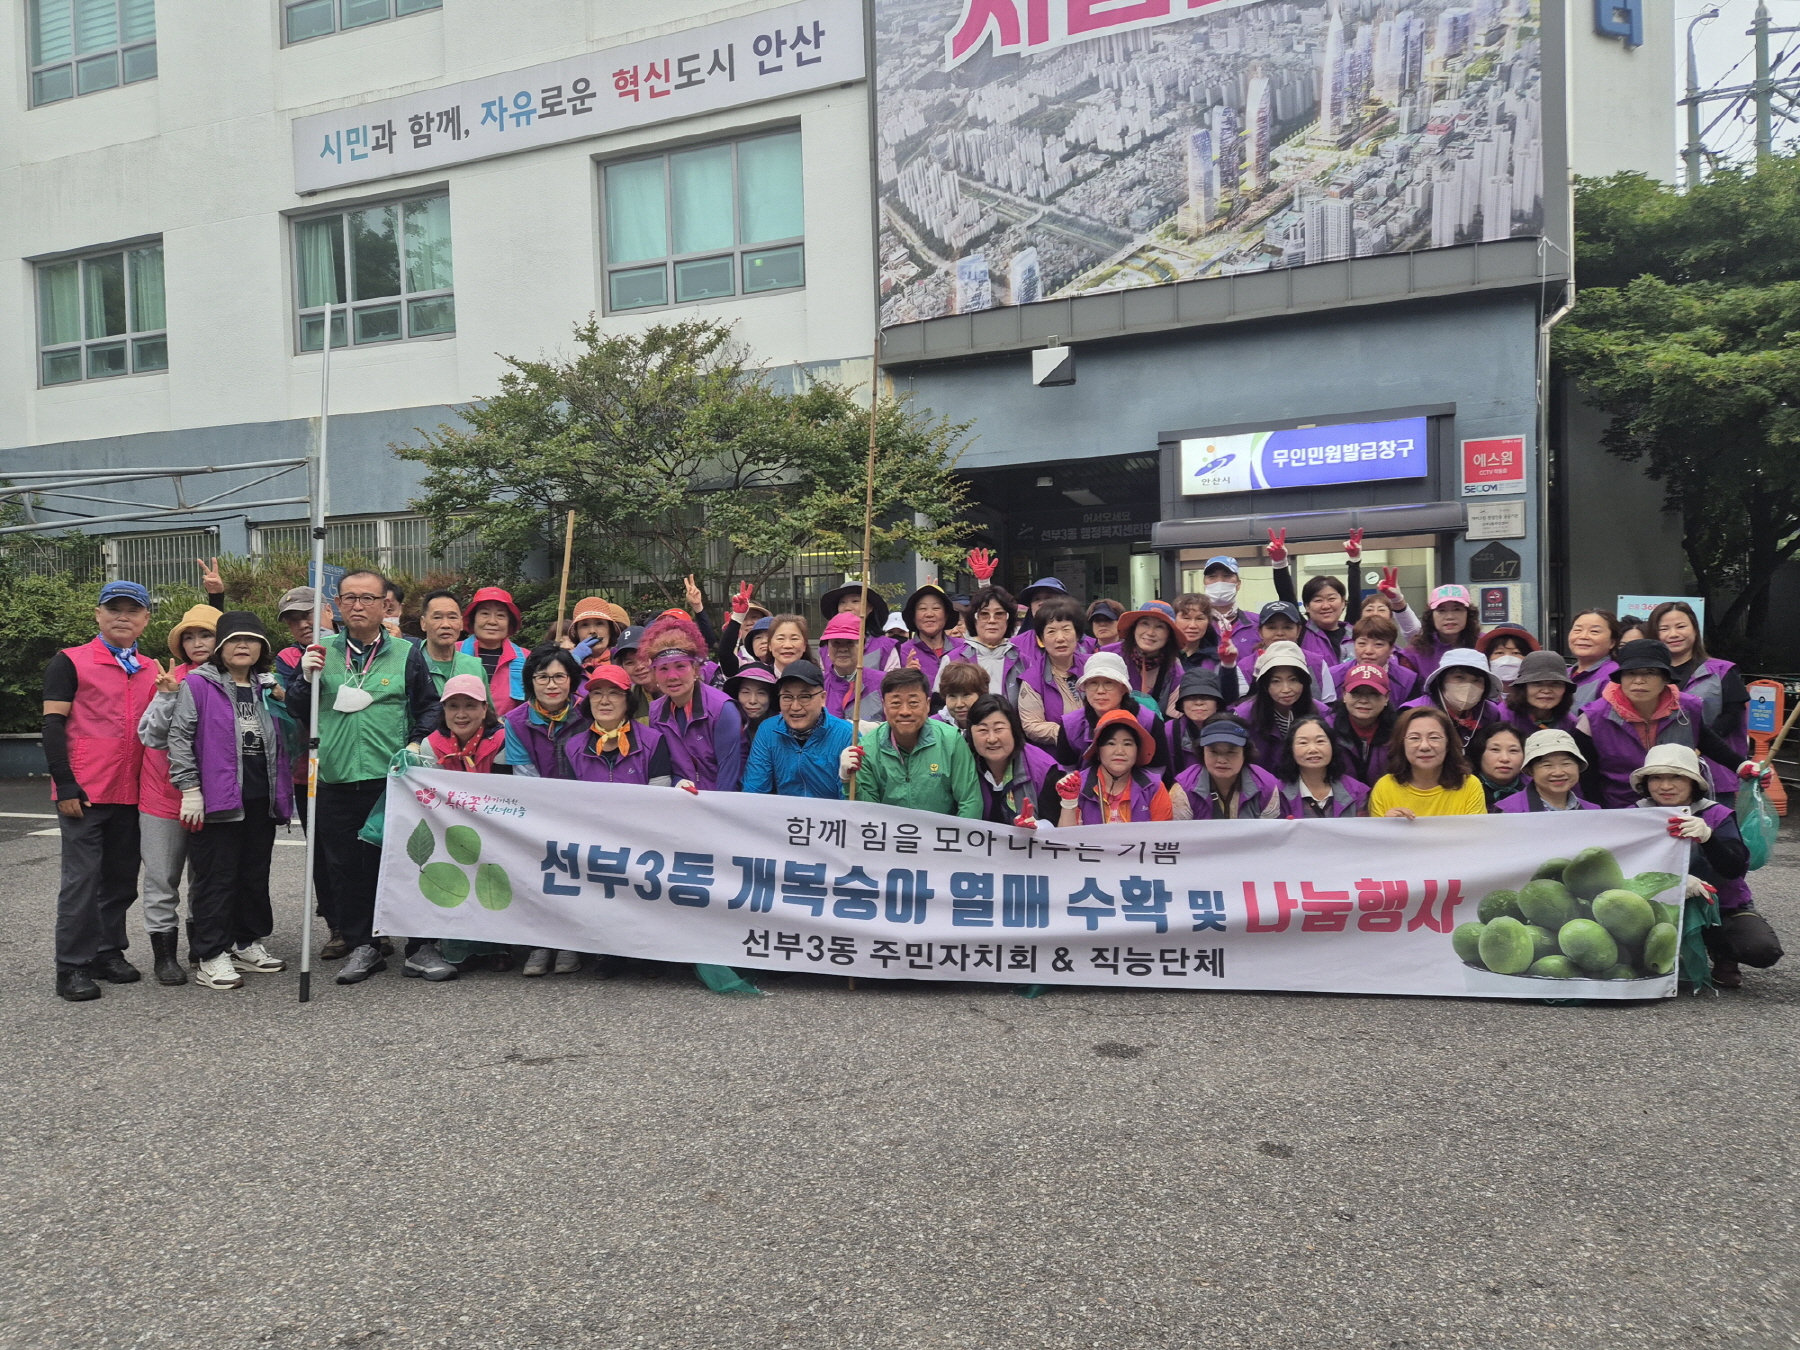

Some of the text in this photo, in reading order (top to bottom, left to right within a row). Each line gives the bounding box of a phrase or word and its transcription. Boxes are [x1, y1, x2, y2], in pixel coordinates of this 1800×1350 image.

[319, 20, 826, 164] 시민과 함께, 자유로운 혁신도시 안산
[1272, 438, 1415, 468] 무인민원발급창구
[1473, 450, 1513, 467] 에스원
[1201, 476, 1232, 486] 안산시
[1464, 484, 1498, 494] SECOM
[1083, 511, 1131, 523] 어서오세요
[1041, 528, 1077, 541] 선부3동
[1493, 560, 1518, 577] 47
[624, 630, 631, 640] P
[1362, 670, 1372, 679] B
[483, 804, 527, 818] 선녀마을
[787, 816, 1181, 865] 함께 힘을 모아 나누는 기쁨
[540, 839, 1464, 934] 선부3동 개복숭아 열매 수확 및 나눔행사
[741, 928, 1226, 979] 선부3동 주민자치회 & 직능단체
